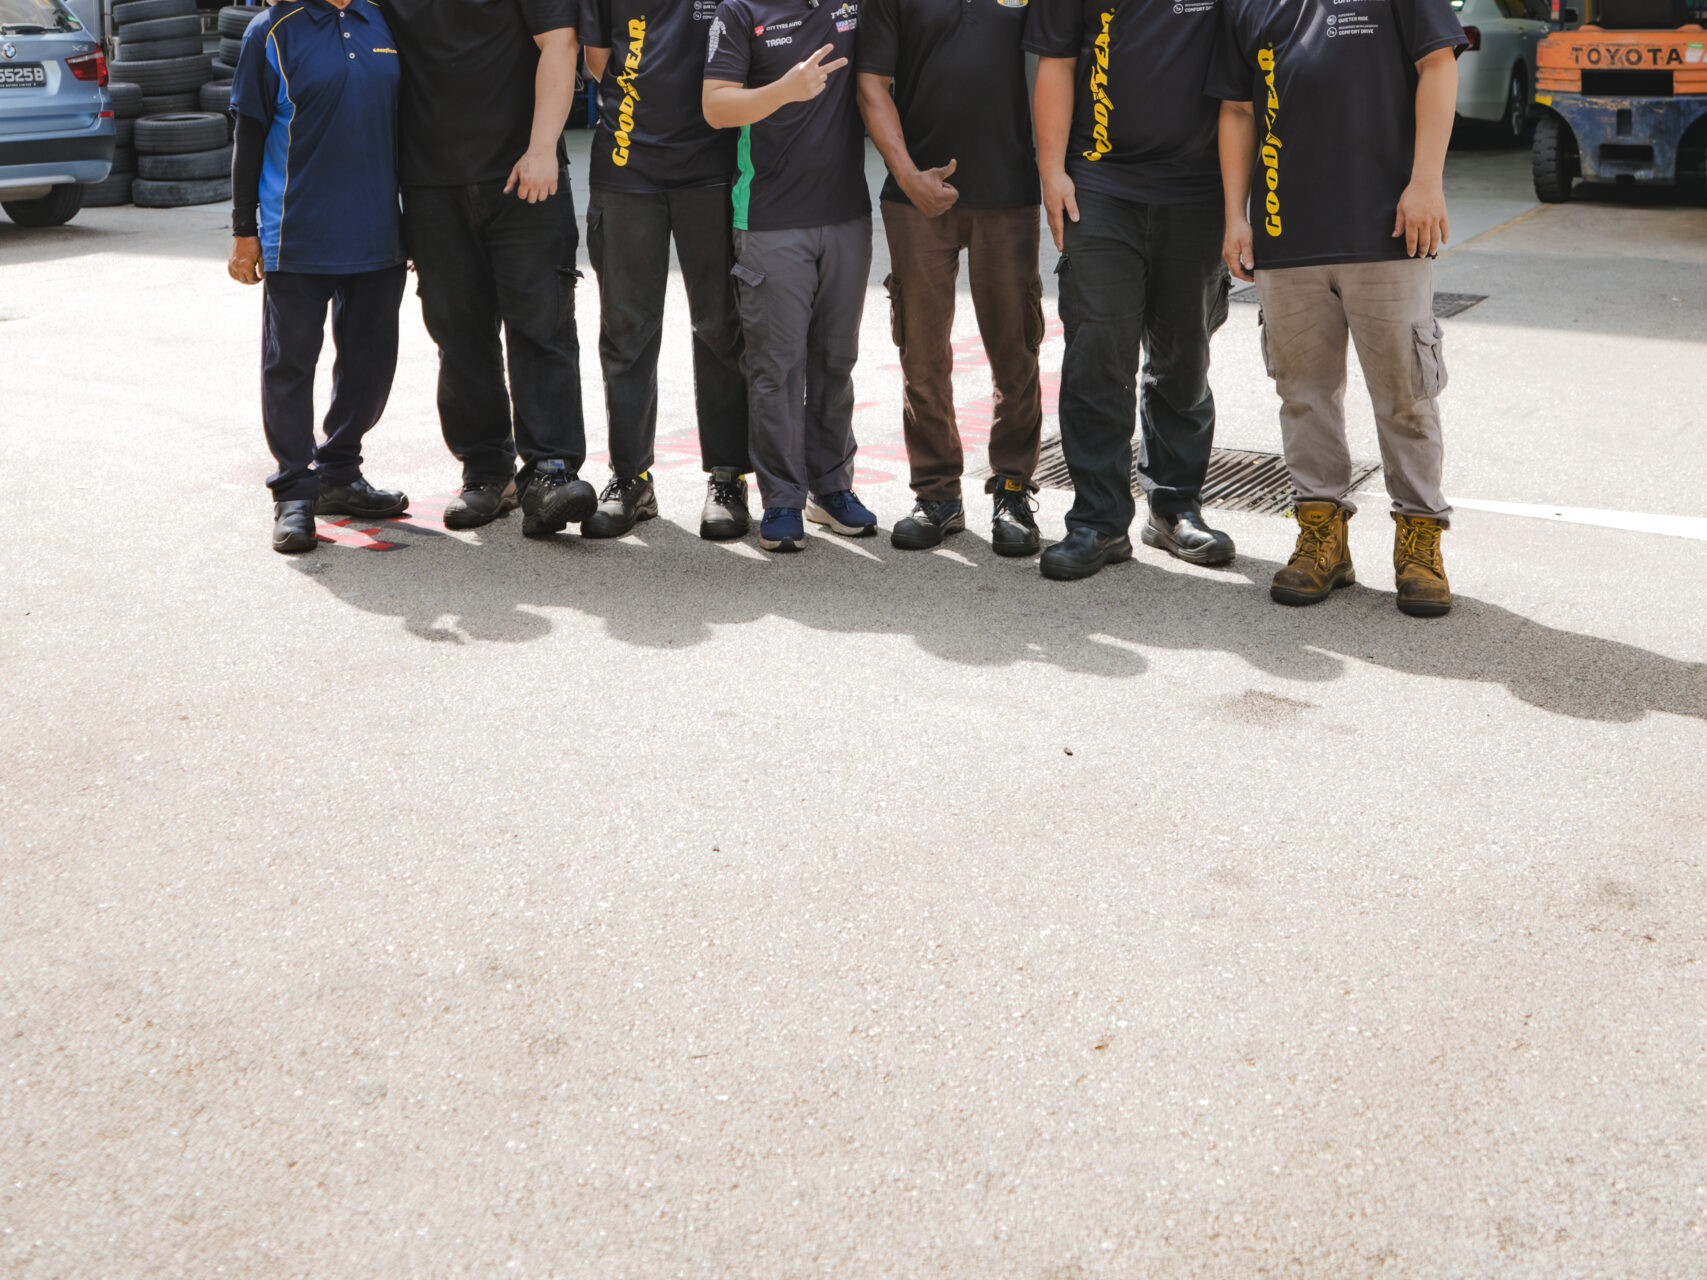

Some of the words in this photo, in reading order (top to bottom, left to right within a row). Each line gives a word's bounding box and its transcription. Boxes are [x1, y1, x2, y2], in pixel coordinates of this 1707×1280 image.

[765, 36, 793, 47] TRAPO
[1572, 47, 1684, 65] TOYOTA
[612, 19, 646, 166] GOODYEAR
